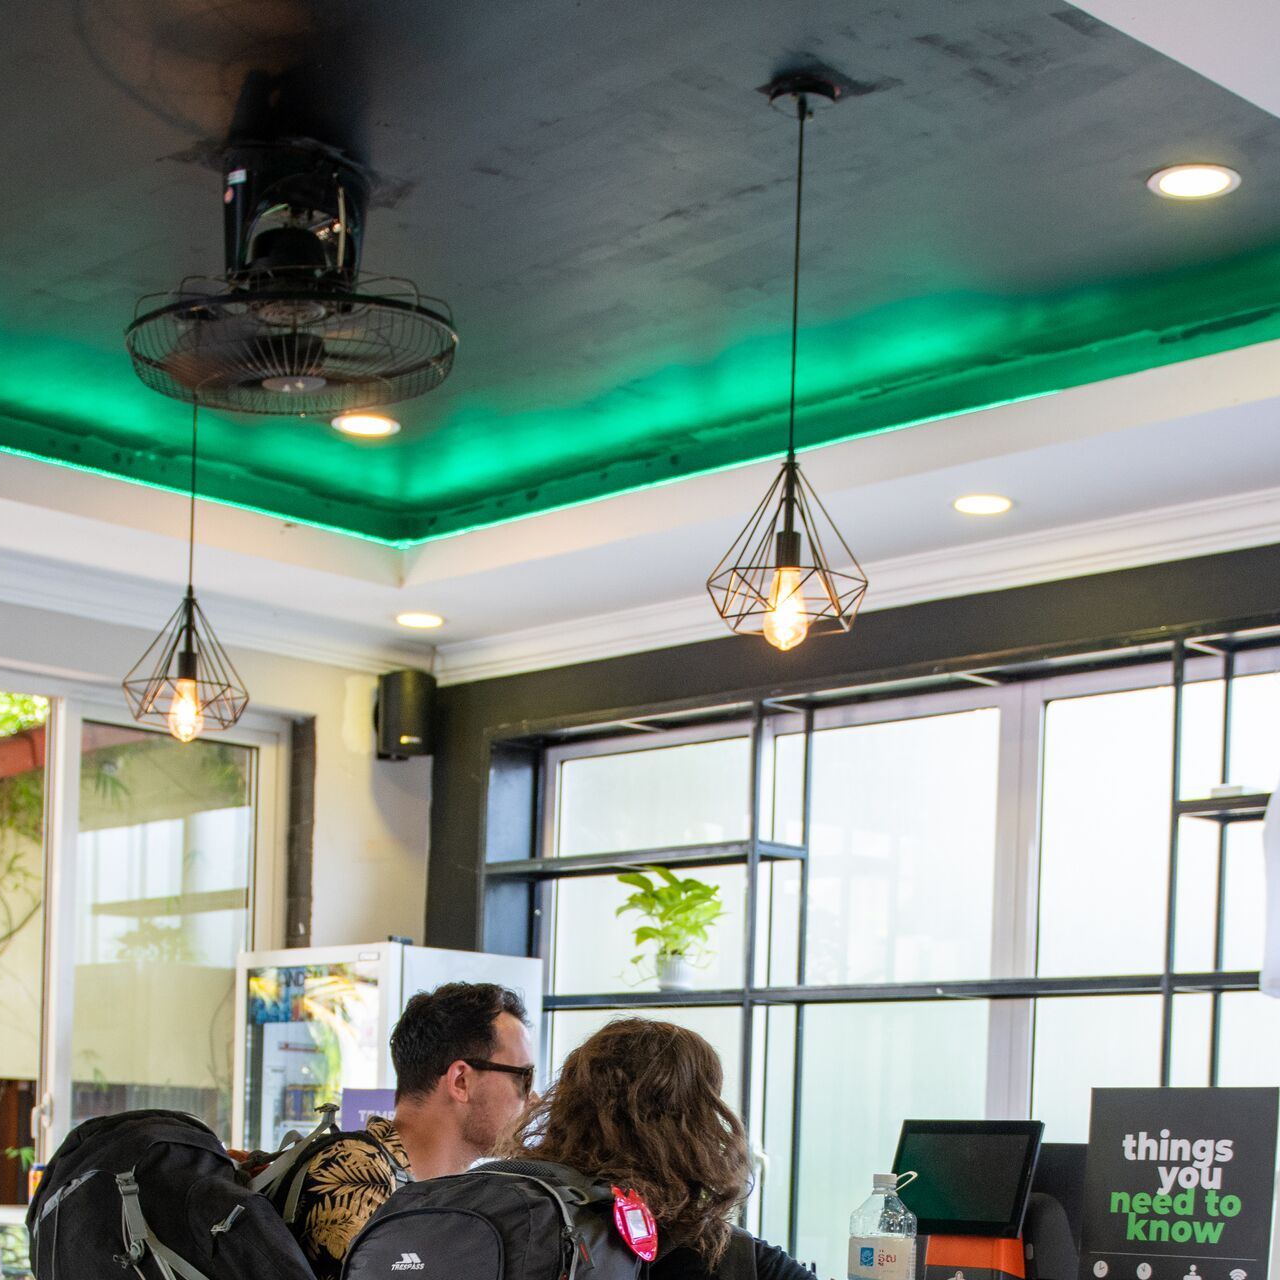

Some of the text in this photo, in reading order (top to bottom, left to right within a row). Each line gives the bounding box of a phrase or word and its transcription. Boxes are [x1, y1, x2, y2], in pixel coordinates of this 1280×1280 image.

[1122, 1129, 1234, 1168] things
[1157, 1167, 1222, 1195] you
[1110, 1188, 1242, 1218] need to
[1127, 1212, 1224, 1243] know
[391, 1263, 424, 1271] TRESPASS
